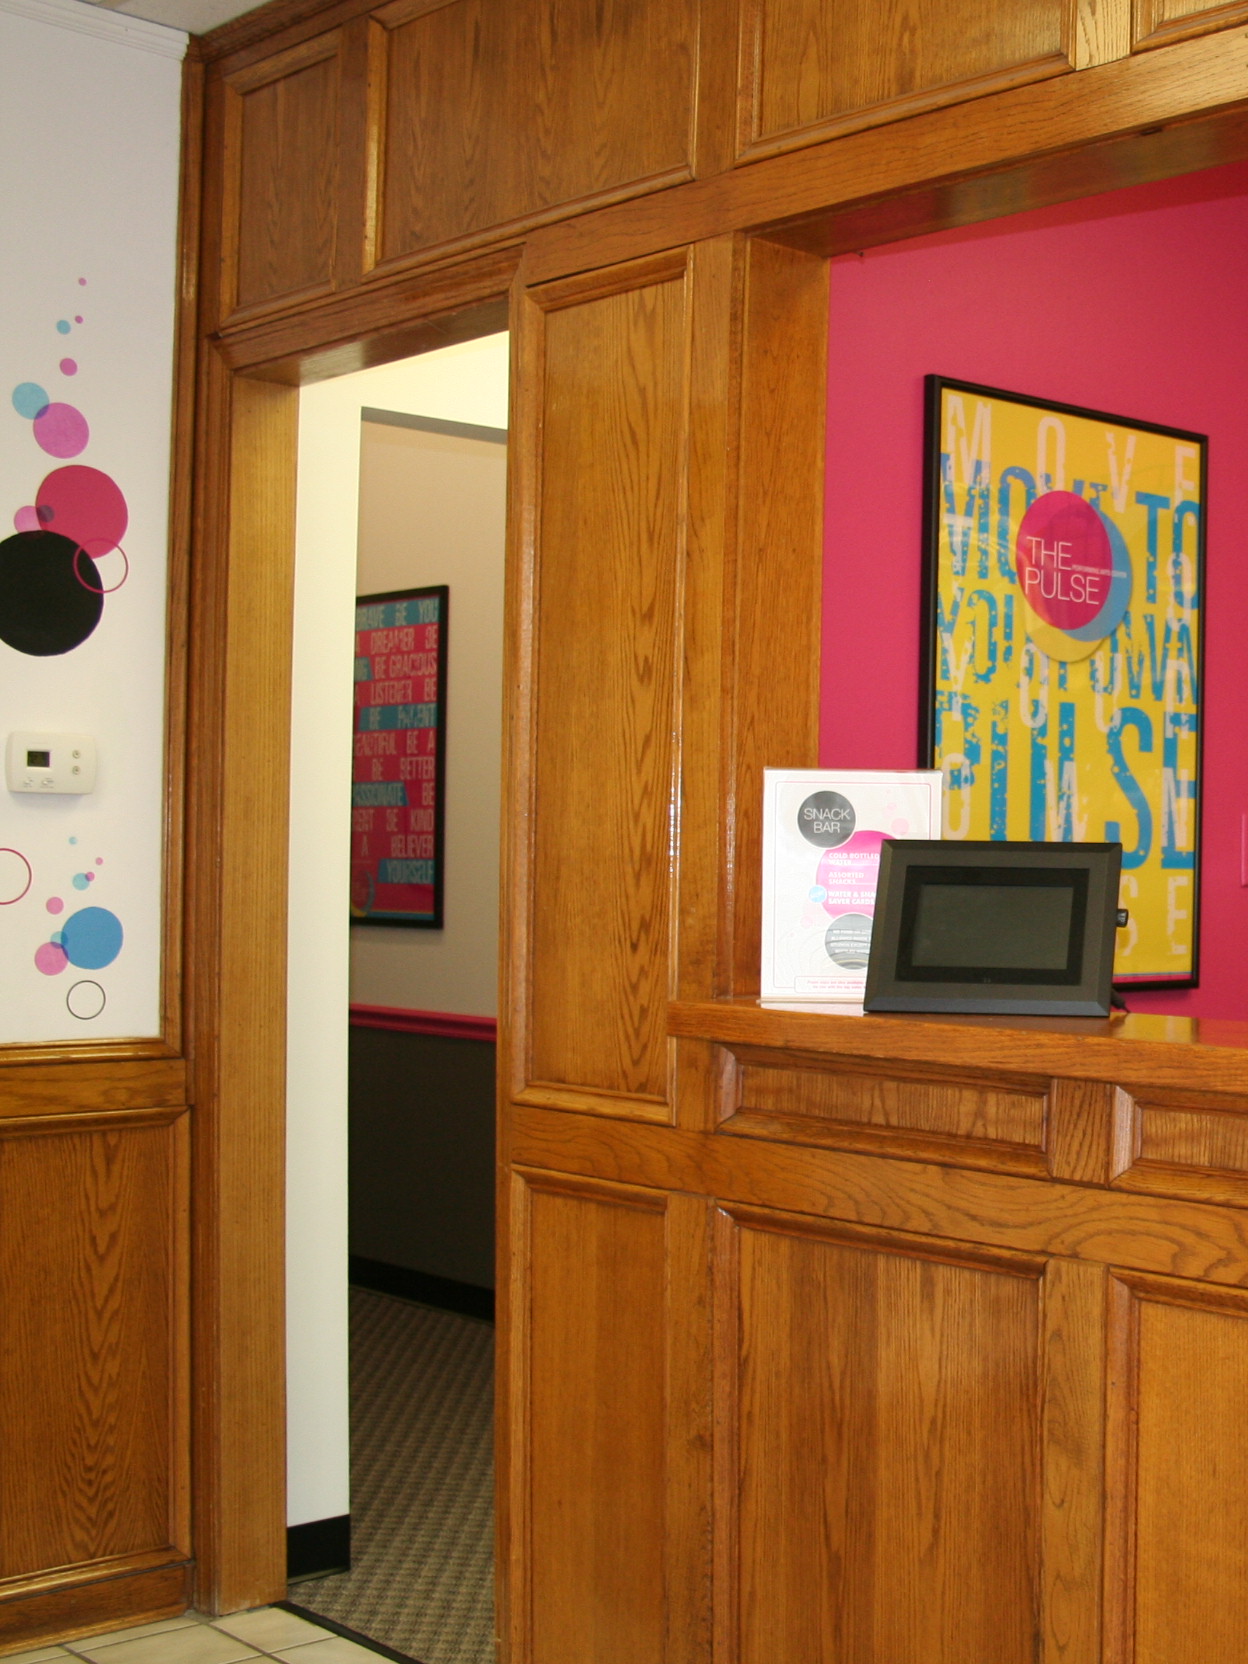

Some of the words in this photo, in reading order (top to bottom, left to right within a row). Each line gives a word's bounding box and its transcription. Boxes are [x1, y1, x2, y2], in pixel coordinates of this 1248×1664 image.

[1026, 536, 1072, 570] THE
[1025, 567, 1100, 605] PULSE
[803, 808, 851, 821] SNACK
[813, 821, 841, 834] BAR
[391, 835, 434, 857] BELIEVER
[849, 852, 880, 860] BOTTLED
